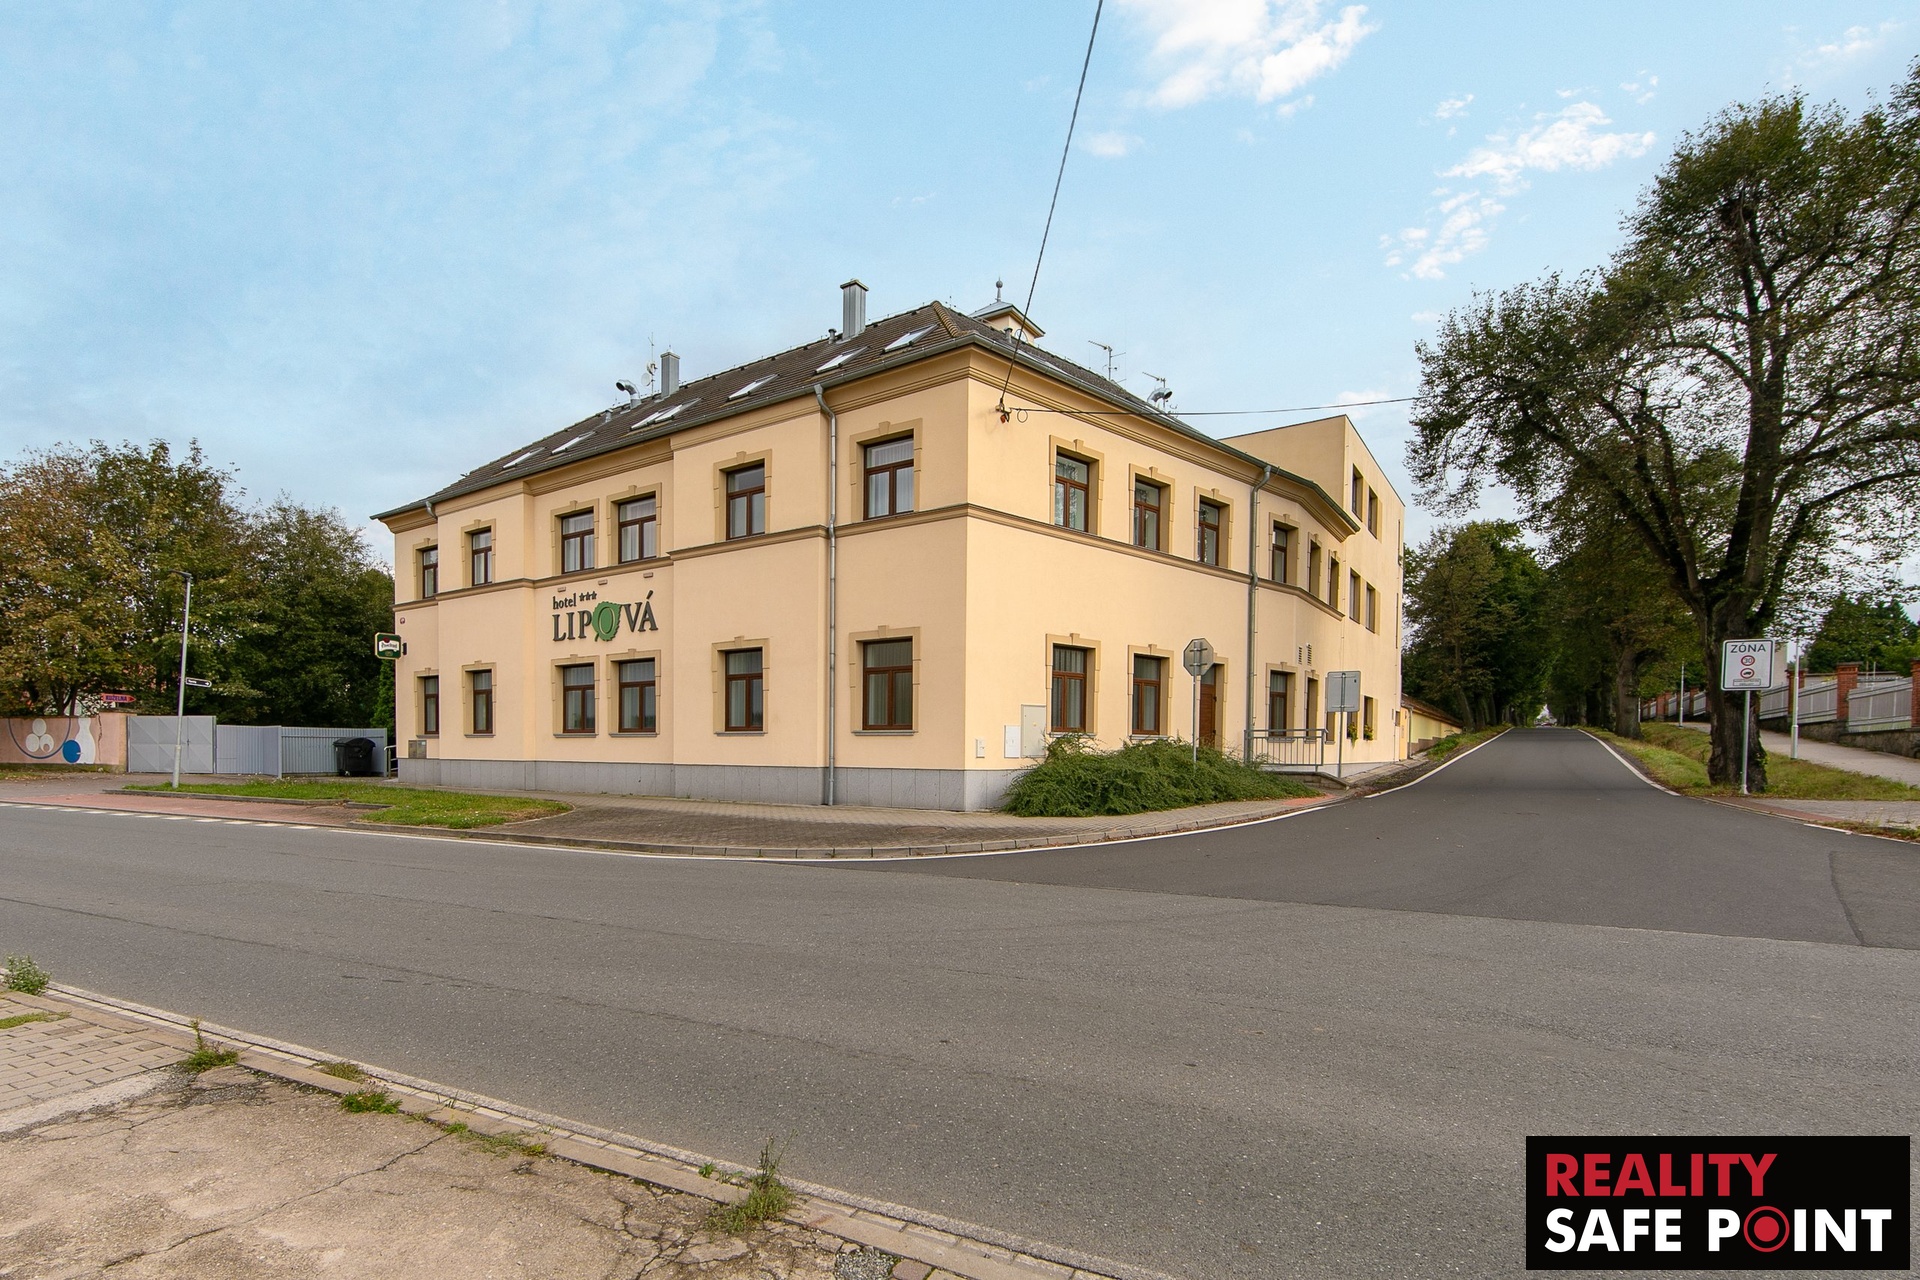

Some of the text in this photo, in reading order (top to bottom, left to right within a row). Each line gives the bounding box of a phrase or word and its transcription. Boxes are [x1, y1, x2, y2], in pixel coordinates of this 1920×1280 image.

[552, 592, 577, 610] hotel
[552, 589, 659, 642] LIPOVÁ
[1730, 642, 1767, 654] ZÓNA
